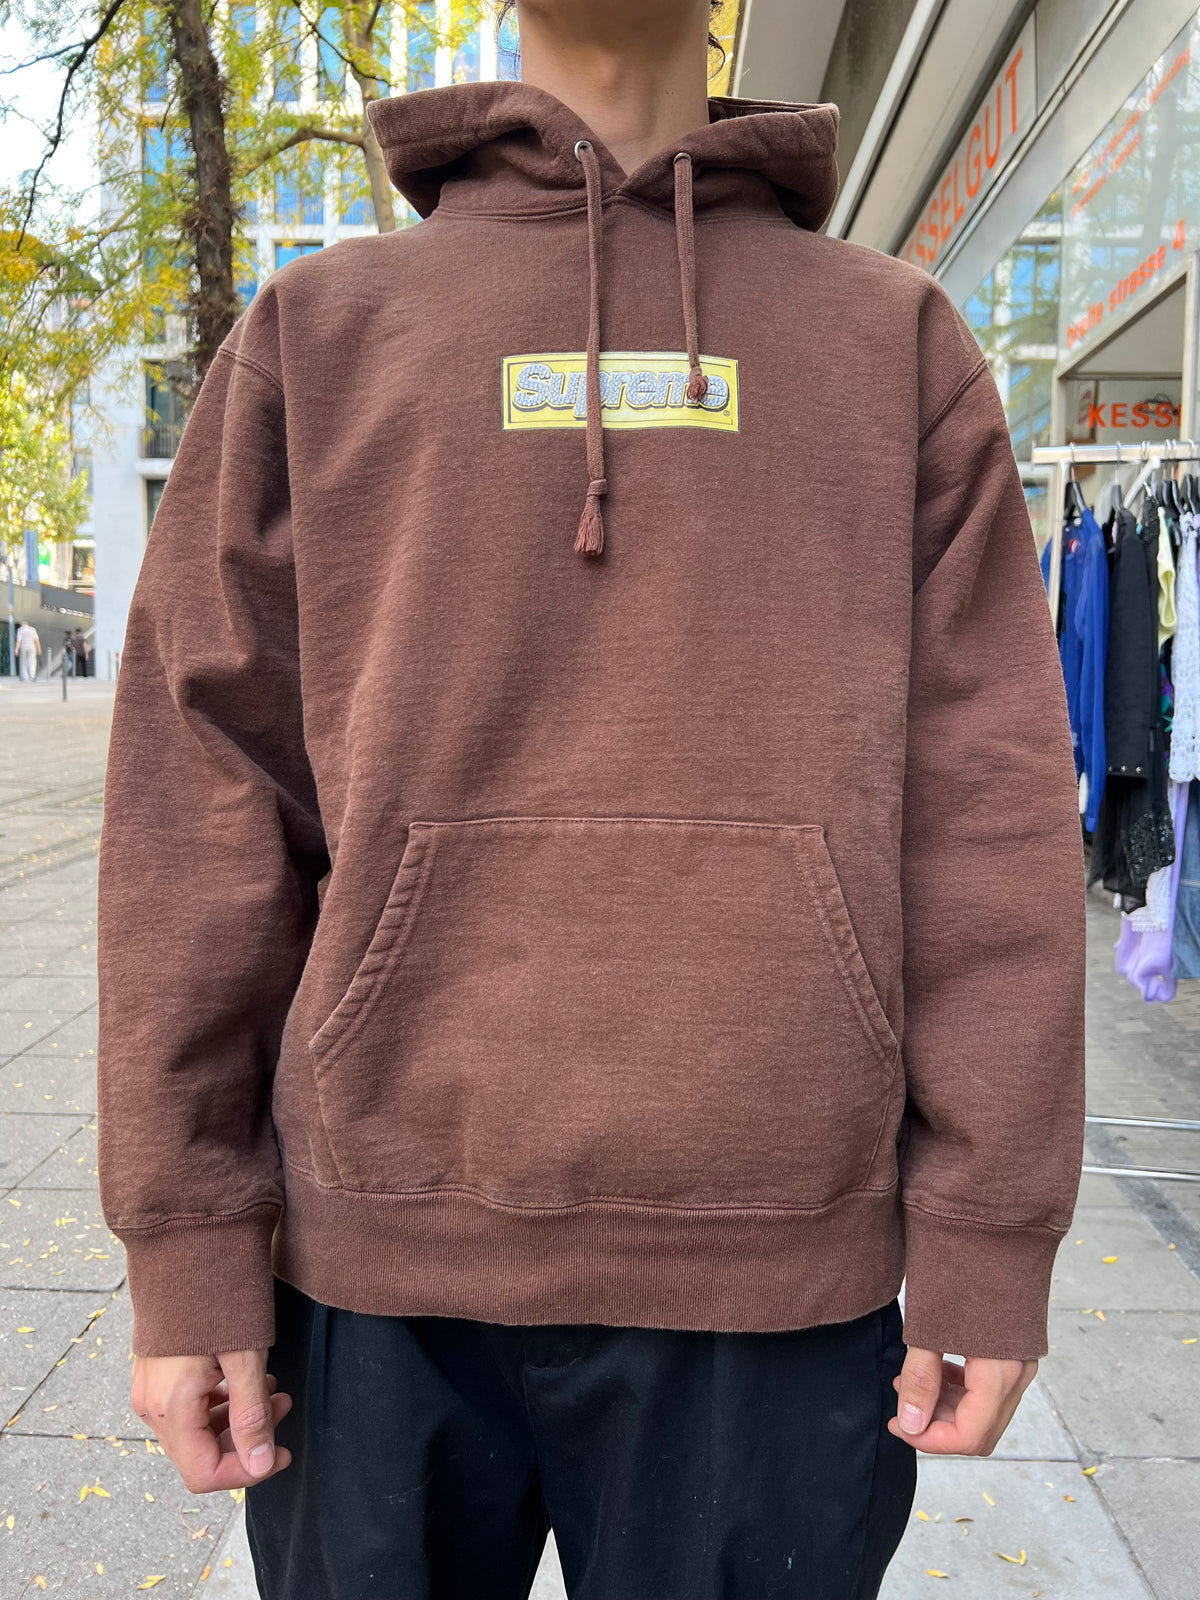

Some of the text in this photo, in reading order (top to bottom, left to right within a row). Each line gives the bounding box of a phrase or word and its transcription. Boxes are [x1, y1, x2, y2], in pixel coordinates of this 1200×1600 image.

[1108, 244, 1166, 312] strasse
[1173, 218, 1186, 251] 4
[513, 363, 730, 419] Supreme
[1088, 402, 1182, 429] KESS
